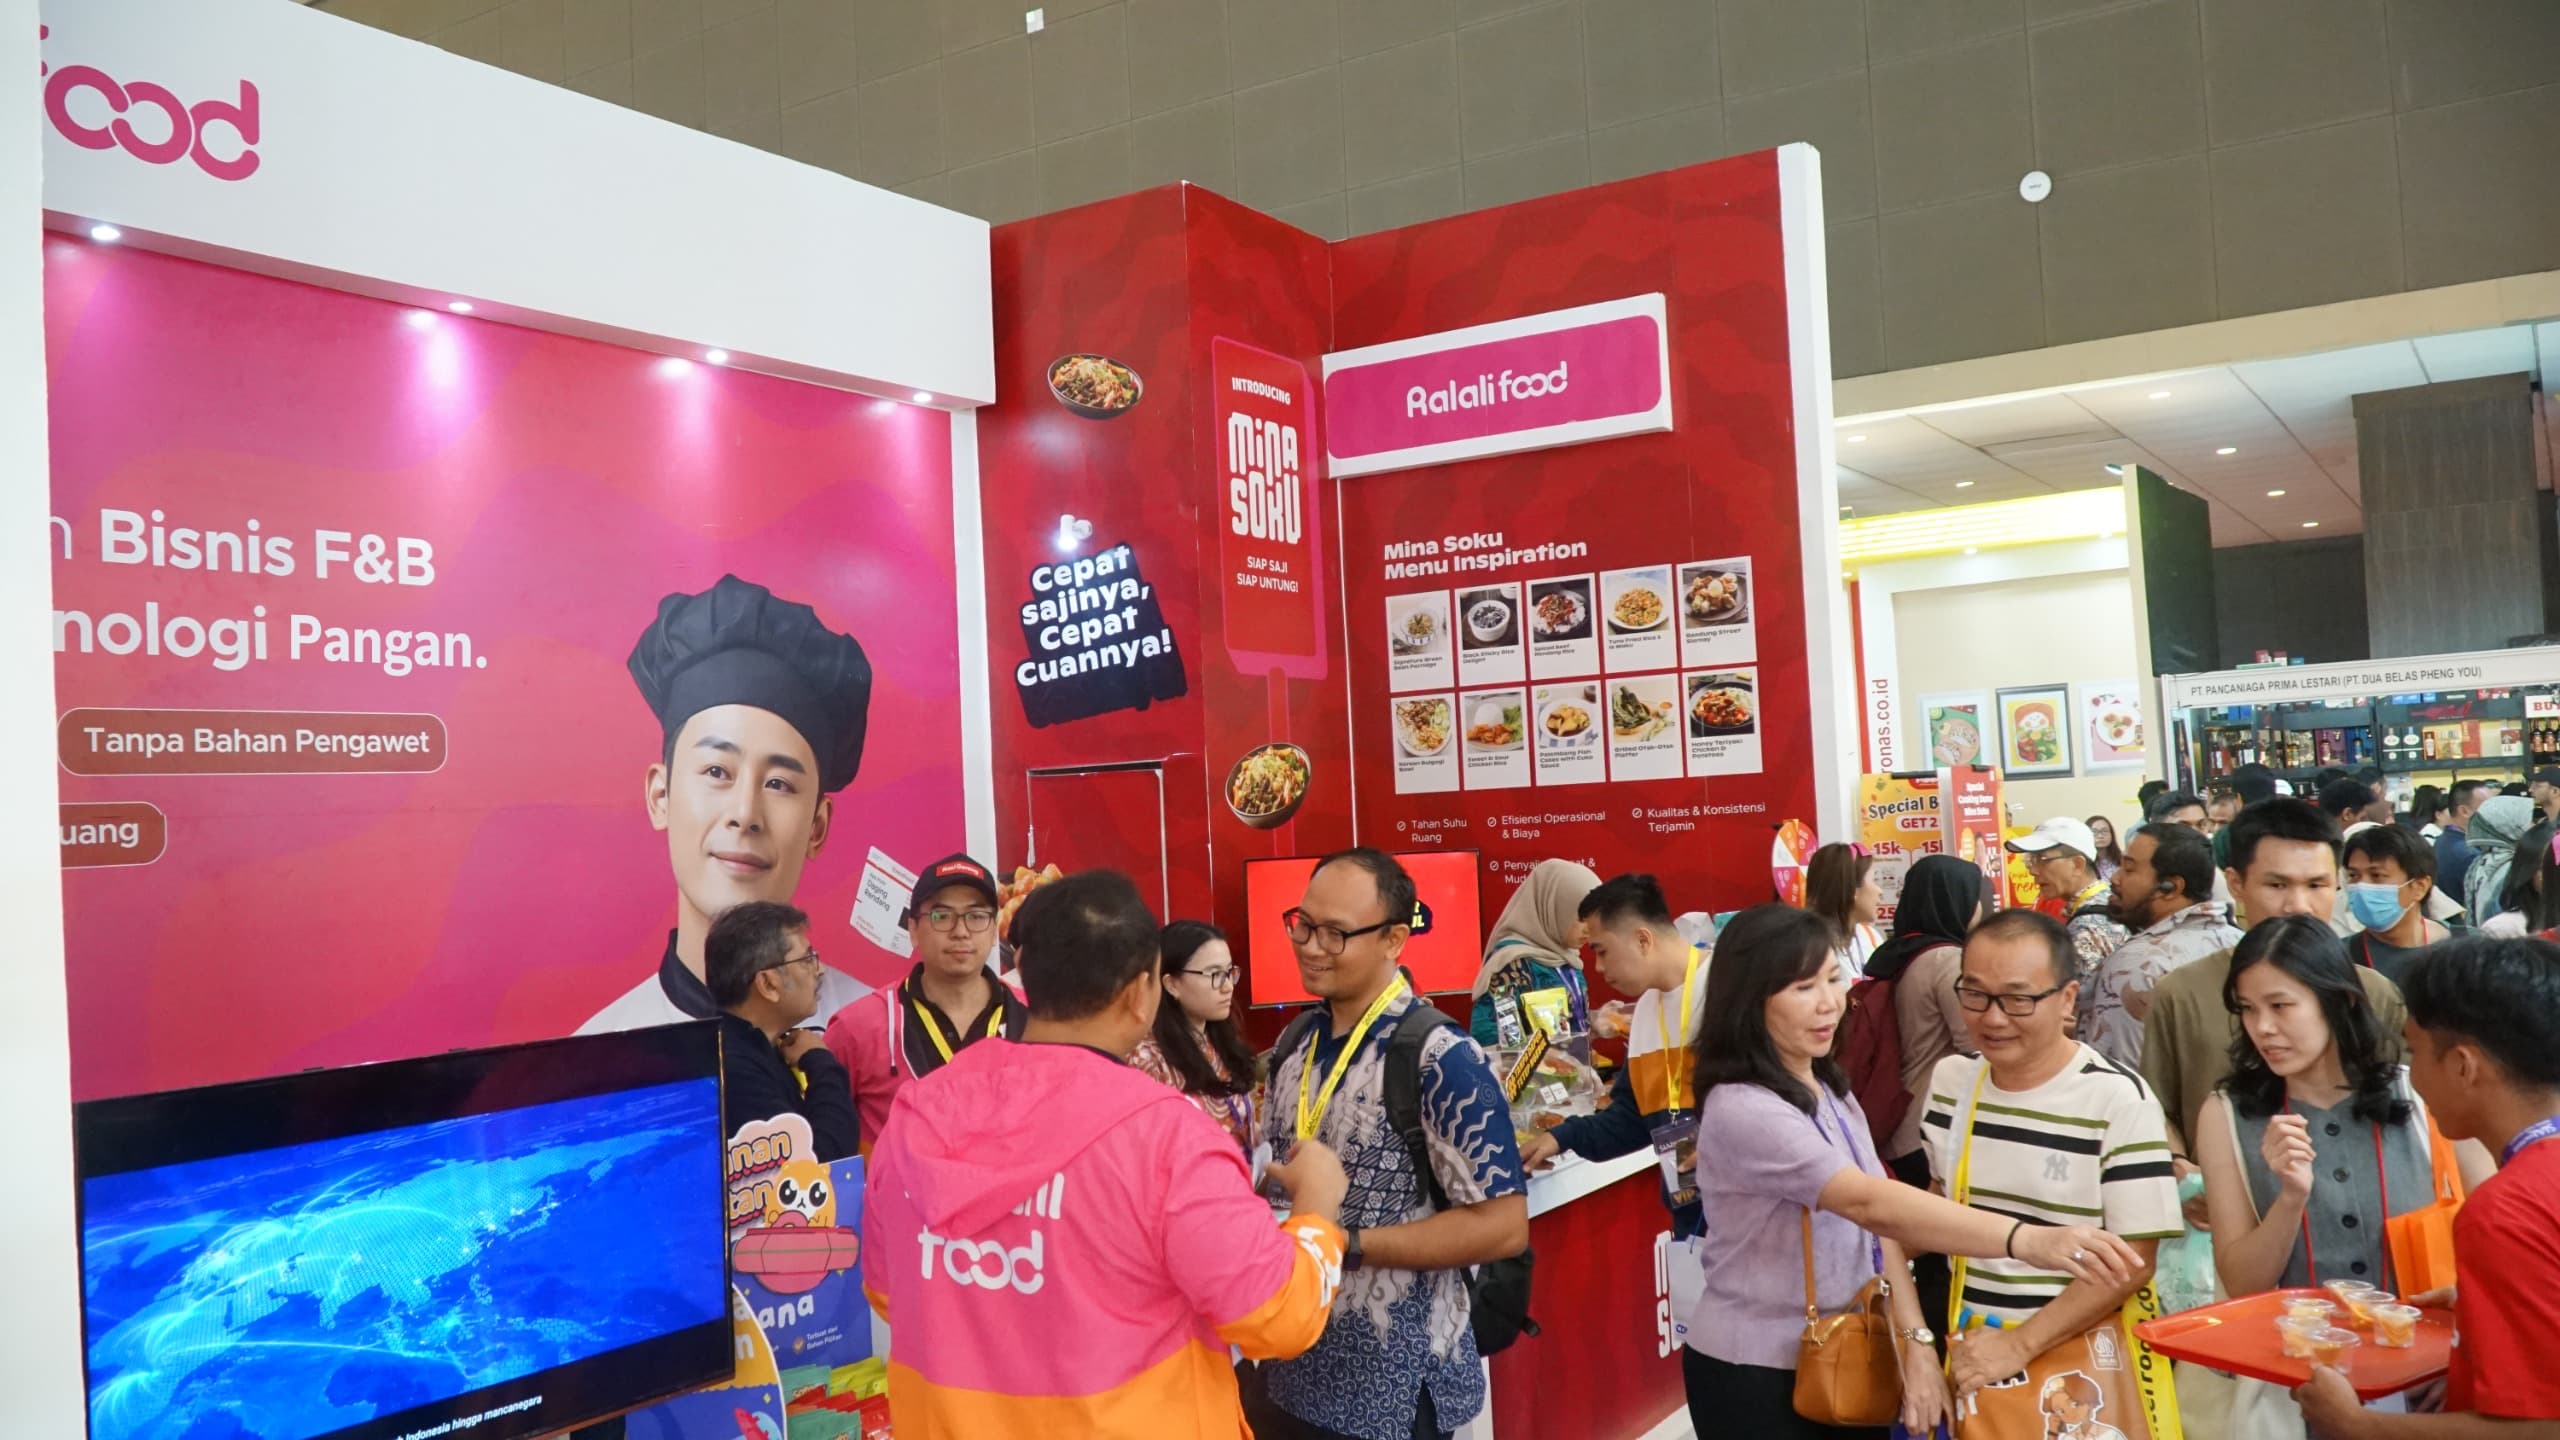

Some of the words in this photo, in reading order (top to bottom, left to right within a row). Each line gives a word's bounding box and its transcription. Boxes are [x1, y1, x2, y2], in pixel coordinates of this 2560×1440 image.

[41, 24, 261, 182] ood
[1231, 377, 1291, 405] INTRODUCING
[100, 508, 296, 577] Bisnis
[315, 529, 436, 587] F&B
[1384, 539, 1439, 560] Mina
[1444, 532, 1503, 552] Soku
[1031, 545, 1130, 592] Cepat
[1247, 555, 1268, 571] SIAP
[1269, 557, 1288, 573] SAJI
[1384, 558, 1448, 580] Menu
[1454, 541, 1587, 571] Inspiration
[1236, 572, 1258, 586] SIAP
[1259, 575, 1299, 593] UNTUNG!
[1021, 577, 1150, 626] sajinya,
[52, 601, 267, 672] nologi
[290, 614, 488, 678] Pangan.
[1039, 605, 1138, 651] Cepat
[1016, 629, 1172, 687] Cuannya!
[2206, 682, 2265, 695] PANCANIAGA
[2268, 679, 2298, 691] PRIMA
[2301, 676, 2341, 689] LESTARI
[2362, 673, 2382, 685] DUA
[2385, 670, 2418, 683] BELAS
[2421, 668, 2454, 680] PHENG
[2457, 666, 2482, 678] YOU)
[1872, 678, 1894, 773] ronas.co.id
[83, 727, 184, 759] Tanpa
[193, 728, 287, 754] Bahan
[295, 729, 430, 758] Pengawet
[1501, 814, 1542, 826] Efisiensi
[1544, 811, 1606, 825] Operasional
[1647, 808, 1690, 818] Kualitas
[1692, 806, 1700, 816] &
[1703, 802, 1766, 816] Konsistensi
[1868, 796, 1924, 820] Special
[1929, 796, 1939, 810] B
[60, 821, 139, 848] uang
[1411, 819, 1441, 830] Tahan
[1442, 818, 1467, 829] Suhu
[1502, 830, 1510, 839] &
[1512, 828, 1540, 840] Biaya
[1648, 822, 1695, 833] Terjamin
[1901, 817, 1929, 829] GET
[1411, 833, 1442, 844] Ruang
[1873, 841, 1901, 855] 15k
[1588, 857, 1596, 867] &
[866, 880, 888, 898] Daging
[1504, 874, 1527, 885] Mud
[864, 888, 890, 912] Rendang
[728, 1131, 791, 1176] nan
[1673, 1189, 1696, 1205] VIP
[757, 1294, 814, 1329] ana
[452, 1413, 483, 1431] hingga
[484, 1395, 543, 1421] mancanegara
